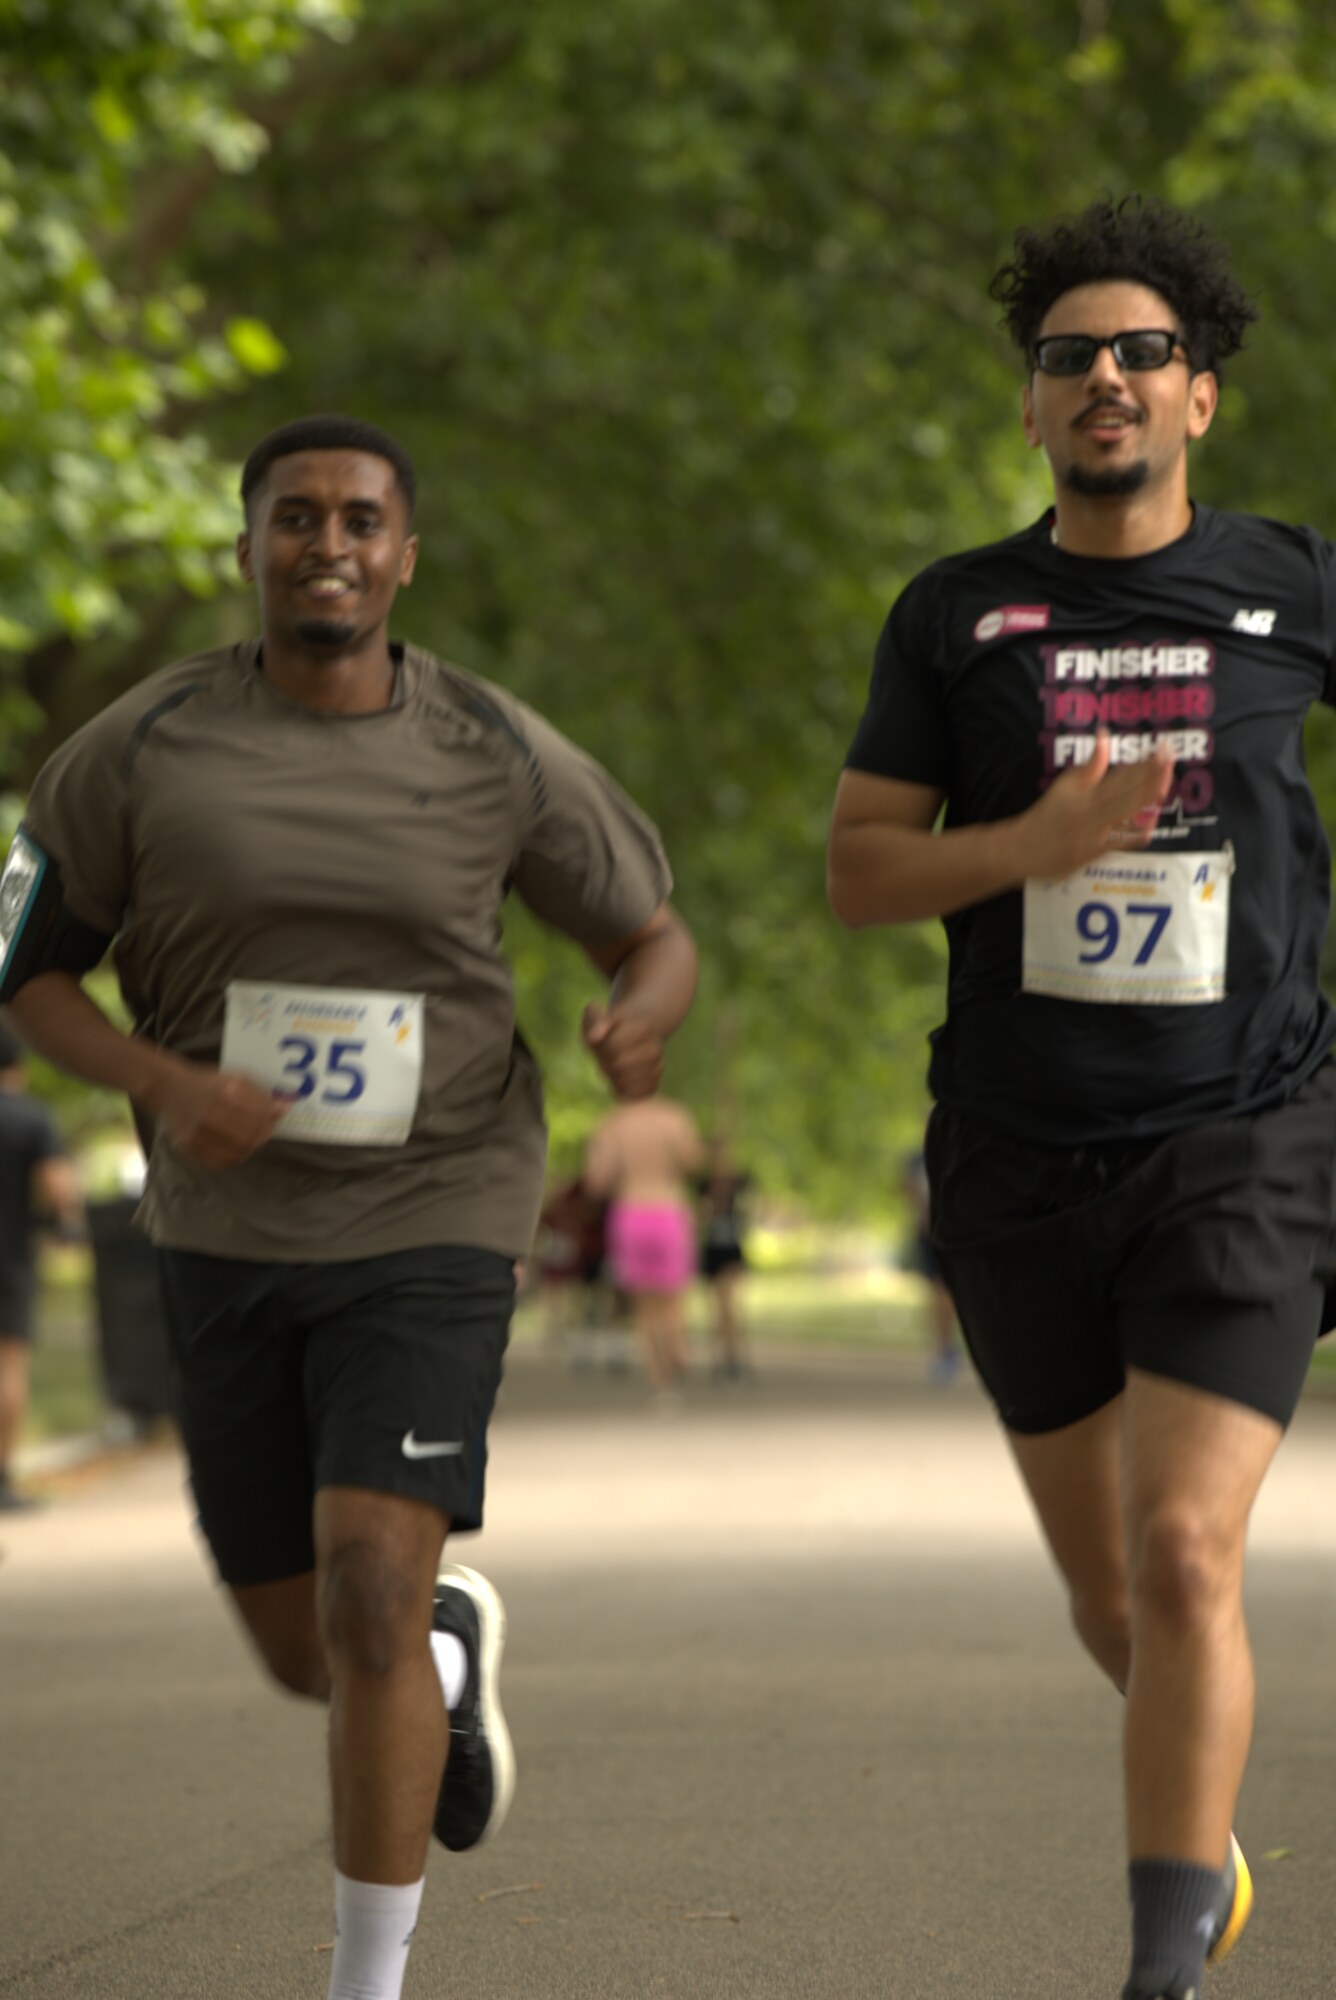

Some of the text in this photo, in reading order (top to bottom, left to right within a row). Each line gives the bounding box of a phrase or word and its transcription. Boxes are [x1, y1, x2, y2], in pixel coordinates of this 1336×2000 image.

[1055, 646, 1210, 680] FINISHER
[1054, 688, 1208, 722] FINISHER
[1076, 902, 1173, 966] 97
[274, 1034, 367, 1104] 35
